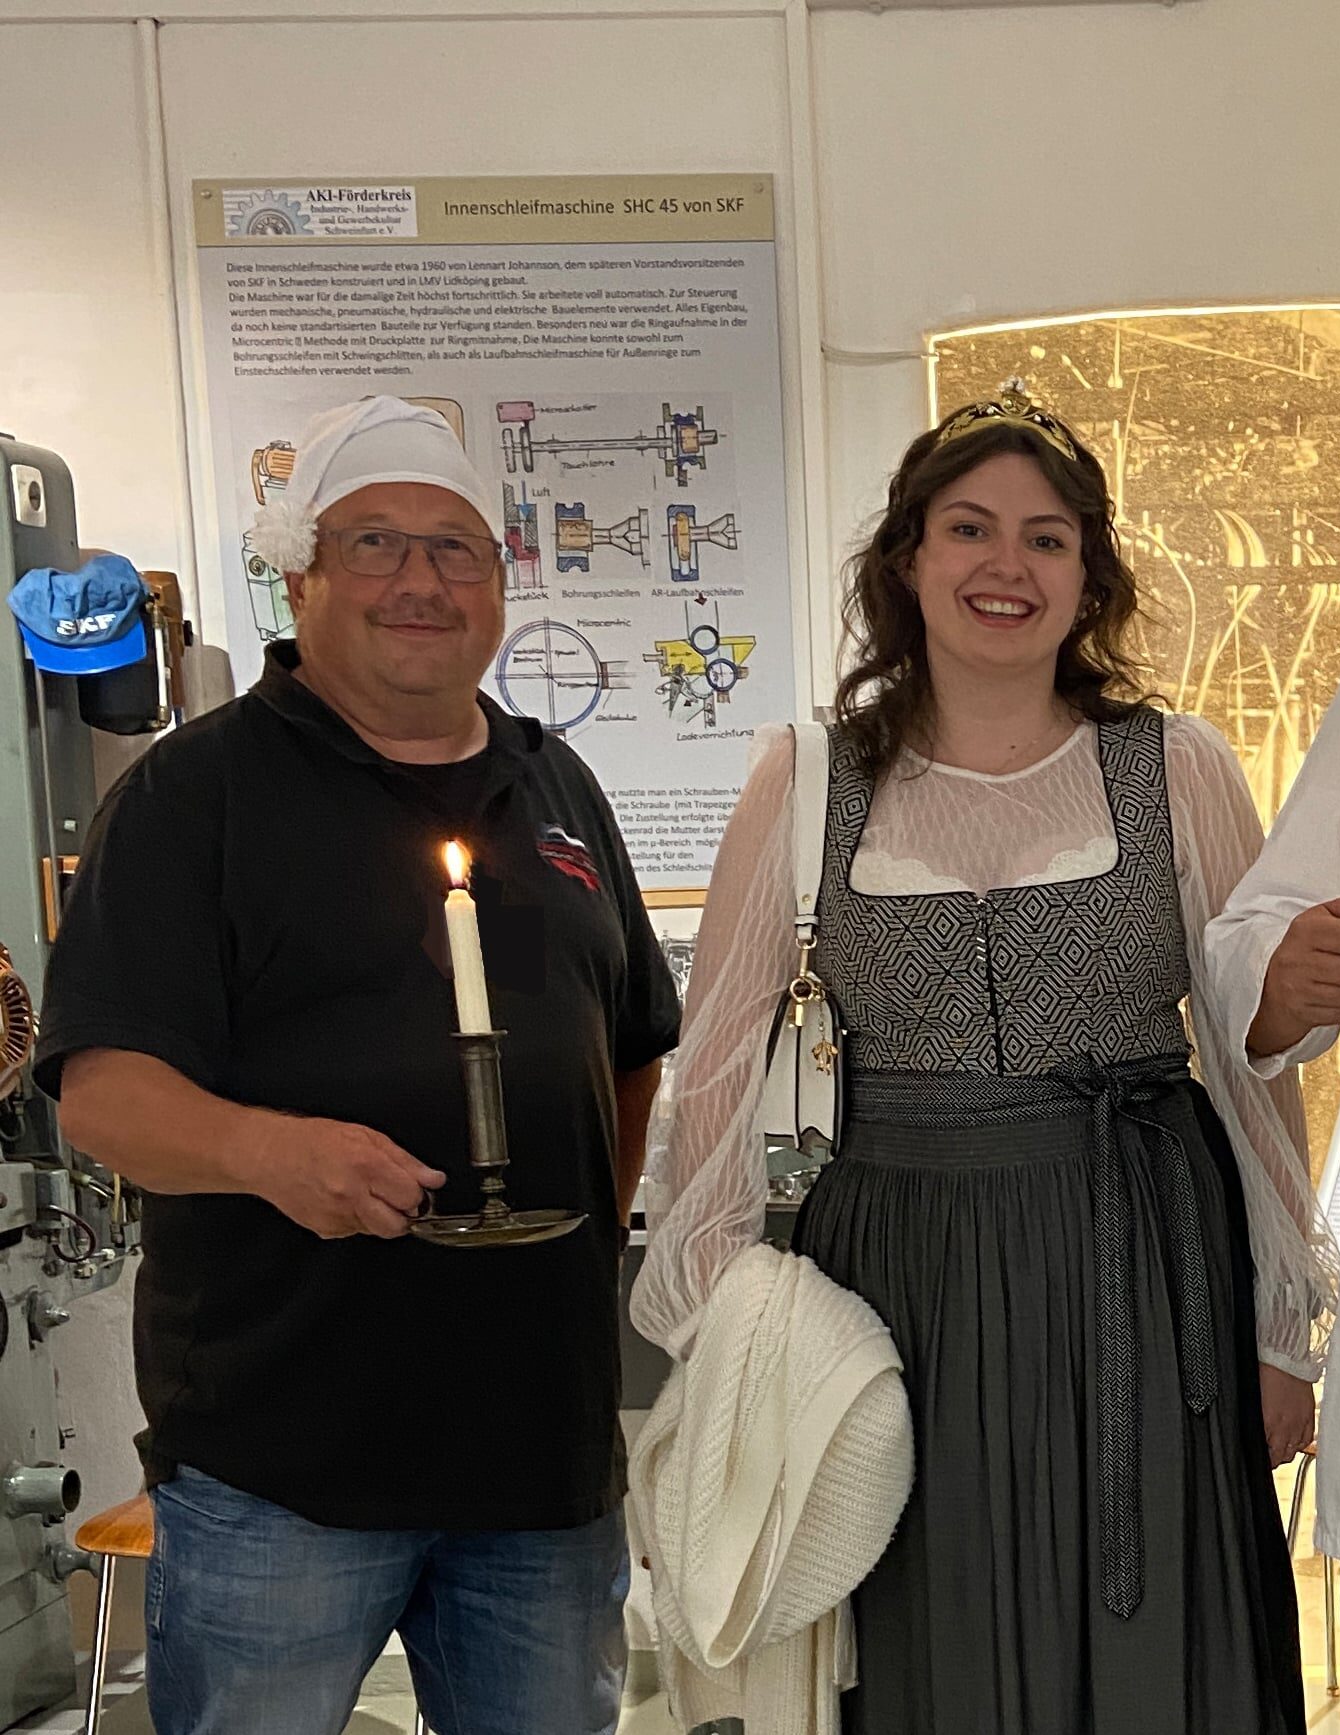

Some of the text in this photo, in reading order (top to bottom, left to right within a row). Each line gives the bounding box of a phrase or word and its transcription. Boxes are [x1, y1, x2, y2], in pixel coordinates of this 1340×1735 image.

[307, 188, 412, 202] AKI-Förderkreis
[444, 198, 744, 216] Innenschleifmaschine SHC 45 von SKF
[227, 263, 252, 272] Diese
[256, 262, 359, 271] Innenschleifmaschine
[361, 262, 392, 271] wurde
[469, 262, 505, 270] Lennart
[565, 261, 586, 270] dem
[589, 260, 631, 270] späteren
[634, 258, 744, 268] Vorstandsvorsitzenden
[248, 278, 264, 286] SKF
[267, 278, 276, 286] in
[279, 278, 328, 286] Schweden
[331, 277, 384, 286] konstruiert
[387, 277, 405, 286] und
[408, 277, 416, 285] in
[492, 276, 528, 286] gebaut.
[229, 293, 245, 301] Die
[248, 293, 293, 301] Maschine
[317, 292, 330, 301] für
[333, 292, 348, 301] die
[351, 292, 394, 303] damalige
[397, 292, 415, 301] Zeit
[418, 291, 449, 300] höchst
[522, 291, 535, 299] Sie
[539, 290, 583, 299] arbeitete
[586, 290, 602, 298] voll
[669, 289, 685, 297] Zur
[688, 289, 737, 299] Steuerung
[230, 308, 267, 316] wurden
[411, 306, 471, 316] hydraulische
[474, 306, 491, 314] und
[495, 306, 547, 314] elektrische
[552, 304, 616, 313] Bauelemente
[619, 304, 673, 313] verwendet.
[675, 304, 698, 312] Alles
[701, 303, 748, 314] Eigenbau,
[231, 323, 242, 331] da
[245, 322, 268, 331] noch
[272, 322, 297, 331] keine
[381, 321, 420, 330] Bauteile
[440, 321, 490, 331] Verfügung
[493, 320, 534, 329] standen.
[537, 320, 587, 329] Besonders
[590, 320, 607, 328] neu
[631, 319, 645, 328] die
[649, 318, 717, 329] Ringaufnahme
[720, 318, 729, 327] in
[732, 318, 747, 326] der
[232, 337, 293, 346] Microcentric
[304, 337, 348, 346] Methode
[351, 337, 367, 345] mit
[369, 336, 425, 346] Druckplatte
[523, 335, 539, 344] Die
[542, 335, 588, 343] Maschine
[590, 334, 623, 342] konnte
[627, 333, 660, 342] sowohl
[663, 334, 683, 342] zum
[234, 352, 320, 362] Bohrungsschleifen
[324, 351, 339, 360] mit
[428, 350, 440, 359] als
[443, 350, 465, 359] auch
[468, 350, 481, 359] als
[484, 349, 604, 358] Laufbahnschleifmaschine
[606, 348, 620, 357] für
[623, 348, 678, 359] Außenringe
[234, 366, 317, 376] Einstechschleifen
[320, 366, 371, 375] verwendet
[532, 487, 551, 497] Luft
[561, 589, 640, 599] Bohrungsschleifen
[651, 588, 744, 598] AR-Laufbahnschleifen
[56, 613, 117, 636] SKF
[669, 788, 682, 796] ein
[631, 801, 670, 809] Schraube
[675, 800, 692, 810] (mit
[636, 813, 679, 823] Zustellung
[682, 813, 714, 823] erfolgte
[671, 826, 700, 834] Mutter
[663, 851, 675, 859] für
[678, 851, 694, 859] den
